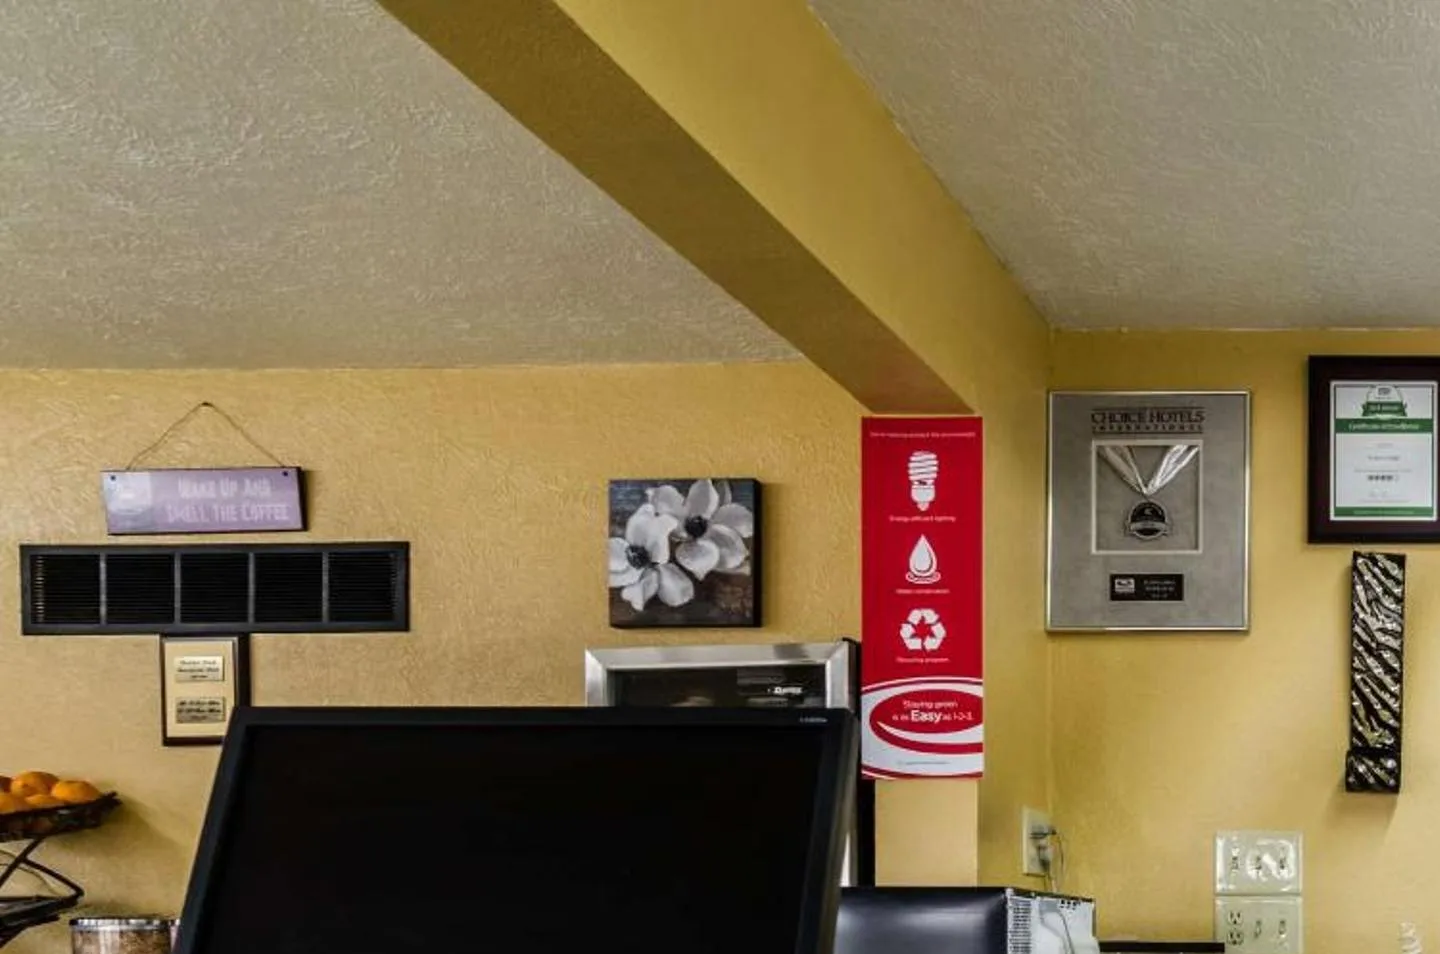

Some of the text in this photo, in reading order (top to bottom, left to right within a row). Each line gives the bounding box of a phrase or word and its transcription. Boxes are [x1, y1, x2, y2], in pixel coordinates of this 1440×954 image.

[1091, 410, 1205, 424] CHOICE HOTELS
[219, 477, 239, 498] UP
[213, 503, 238, 522] THE
[242, 502, 290, 521] COFFEE
[910, 709, 943, 724] Easy
